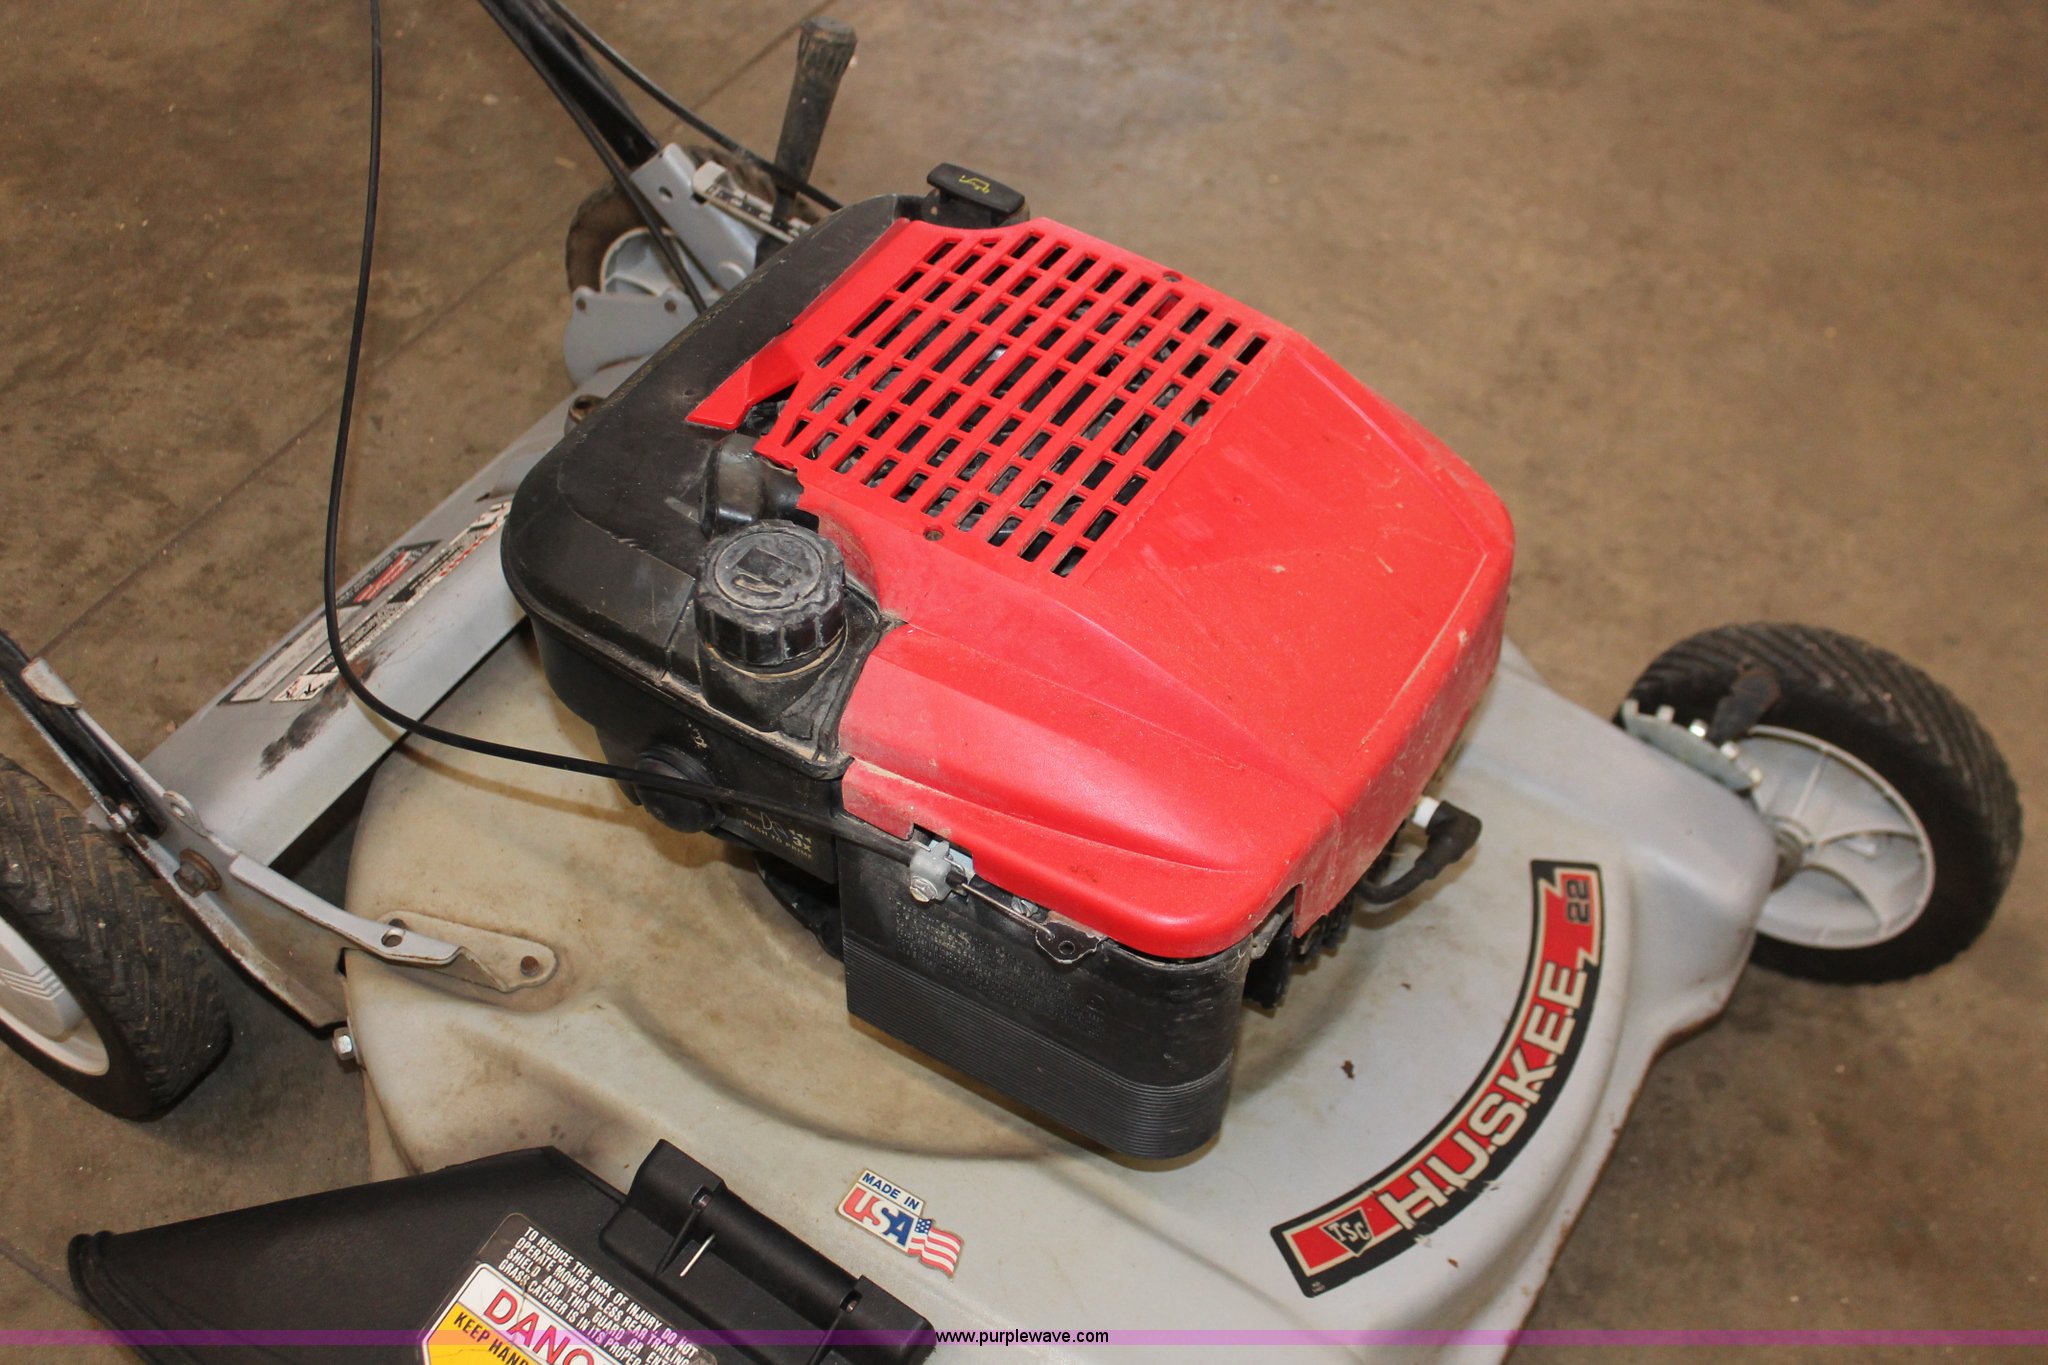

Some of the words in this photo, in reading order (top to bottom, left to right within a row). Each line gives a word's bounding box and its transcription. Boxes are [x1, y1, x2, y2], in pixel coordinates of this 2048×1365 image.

[1566, 878, 1589, 924] 22
[1377, 961, 1588, 1231] HUSKEE
[843, 1186, 915, 1247] USA
[862, 1172, 901, 1200] MADE
[903, 1196, 920, 1211] IN
[1327, 1221, 1371, 1242] TSC
[498, 1259, 531, 1287] GRASS
[527, 1280, 569, 1317] CATCHER
[565, 1308, 580, 1324] IS
[575, 1316, 592, 1332] IN
[587, 1325, 607, 1345] ITS
[506, 1247, 542, 1278] SHIELD
[541, 1274, 565, 1296] AND
[566, 1291, 591, 1314] THIS
[591, 1310, 626, 1342] GUARD
[626, 1337, 645, 1355] OR
[514, 1236, 557, 1273] OPERATE
[552, 1264, 590, 1297] MOWER
[586, 1292, 624, 1321] UNLESS
[621, 1315, 649, 1343] REAR
[523, 1226, 540, 1242] TO
[536, 1236, 575, 1268] REDUCE
[571, 1260, 593, 1282] THE
[589, 1275, 615, 1299] RISK
[612, 1292, 630, 1308] OF
[661, 1327, 678, 1345] DO
[675, 1337, 699, 1359] NOT
[453, 1311, 491, 1343] KEEP
